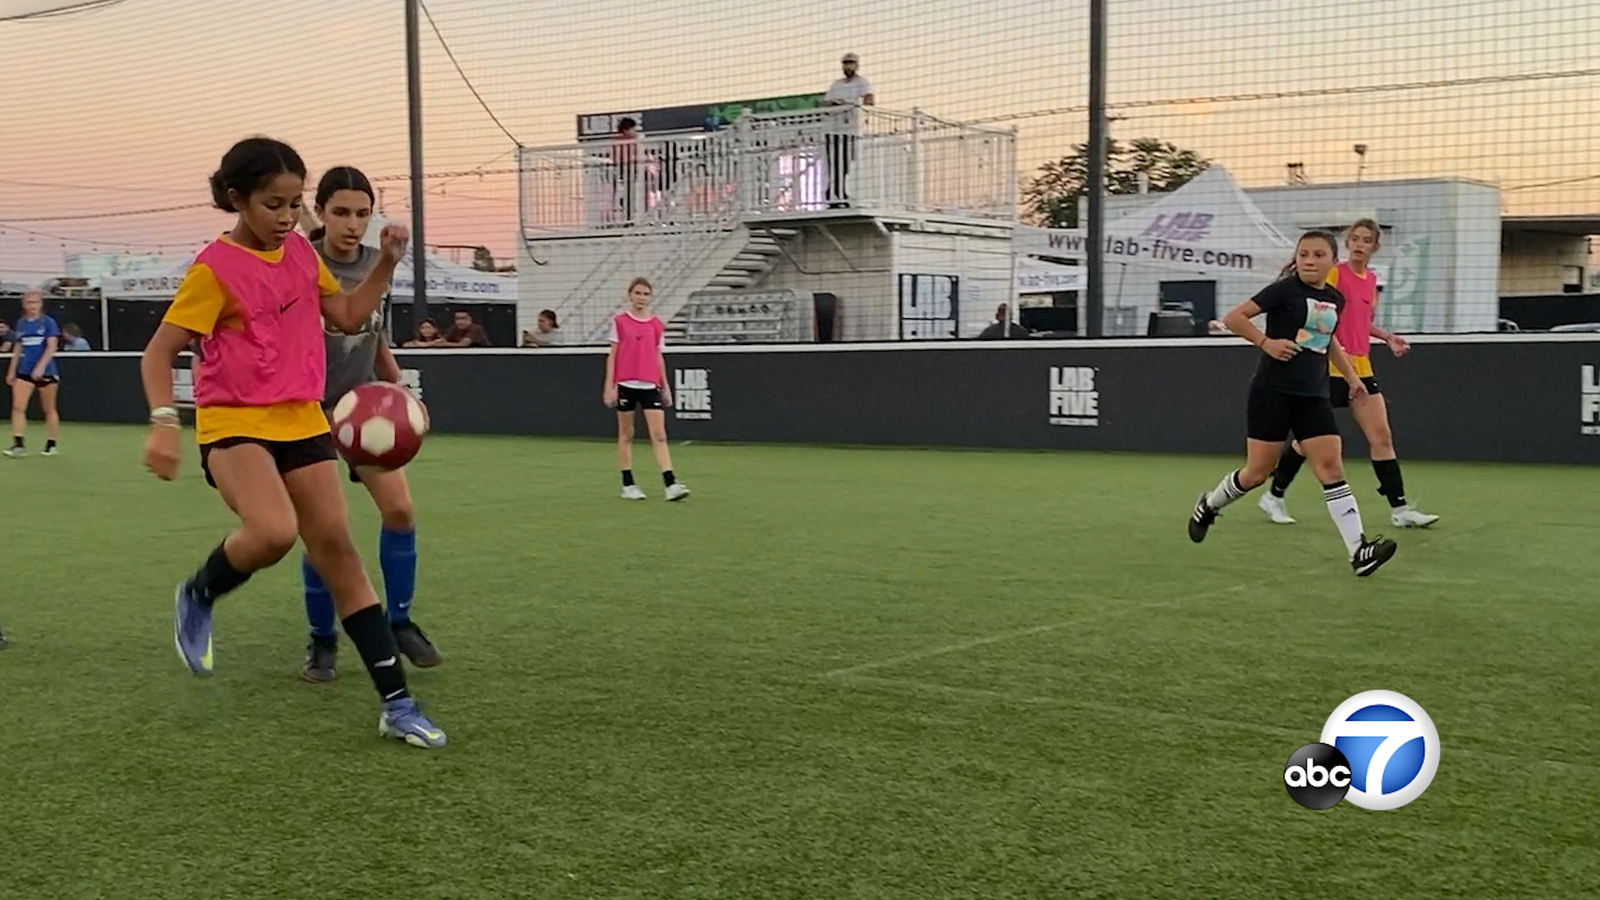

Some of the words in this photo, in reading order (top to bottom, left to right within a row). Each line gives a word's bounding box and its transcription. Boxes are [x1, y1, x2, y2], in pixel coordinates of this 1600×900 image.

[1048, 233, 1253, 269] wwlab-five.com
[902, 275, 952, 318] LAB
[675, 369, 708, 389] LAB
[1050, 366, 1095, 390] LAB
[675, 390, 711, 410] FIVE
[1050, 391, 1099, 415] FIVE
